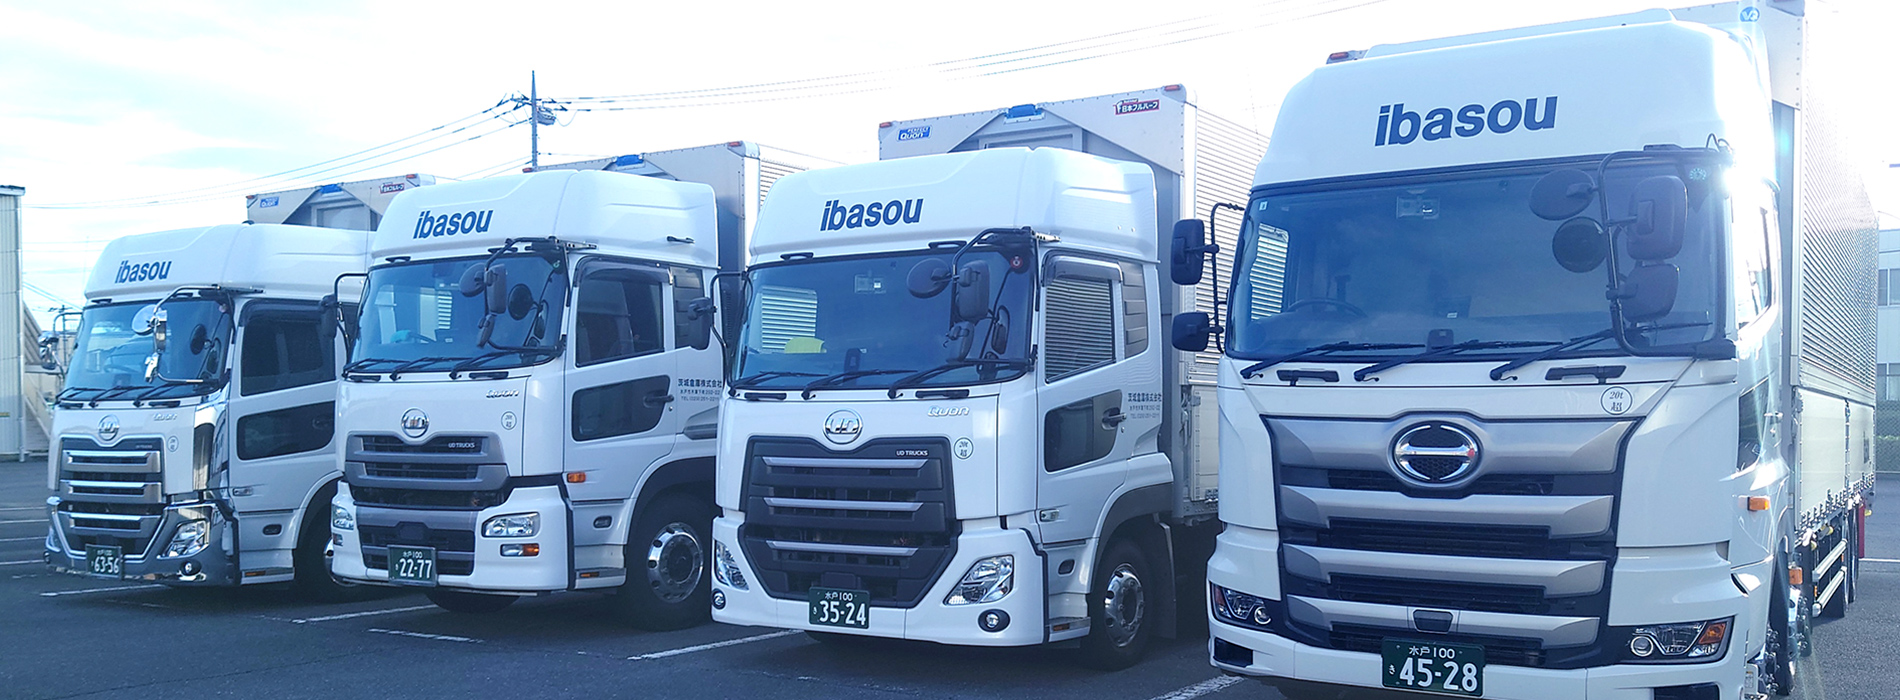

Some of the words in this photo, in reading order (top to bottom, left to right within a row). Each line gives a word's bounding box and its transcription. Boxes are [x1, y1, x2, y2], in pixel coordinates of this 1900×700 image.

[1122, 102, 1158, 113] 日本フルハーフ
[1375, 96, 1558, 146] ibasou
[900, 132, 924, 140] Quon
[413, 210, 494, 239] ibasou
[820, 199, 924, 231] ibasou
[114, 260, 172, 283] ibasou
[486, 389, 519, 398] Quon
[1609, 391, 1624, 399] 20t
[927, 405, 970, 417] Quon
[1610, 402, 1622, 412] 超
[94, 556, 119, 574] 63-56
[399, 558, 432, 578] 22-77
[819, 599, 866, 626] 35-24
[1388, 664, 1396, 675] き
[1399, 657, 1478, 692] 45-28
